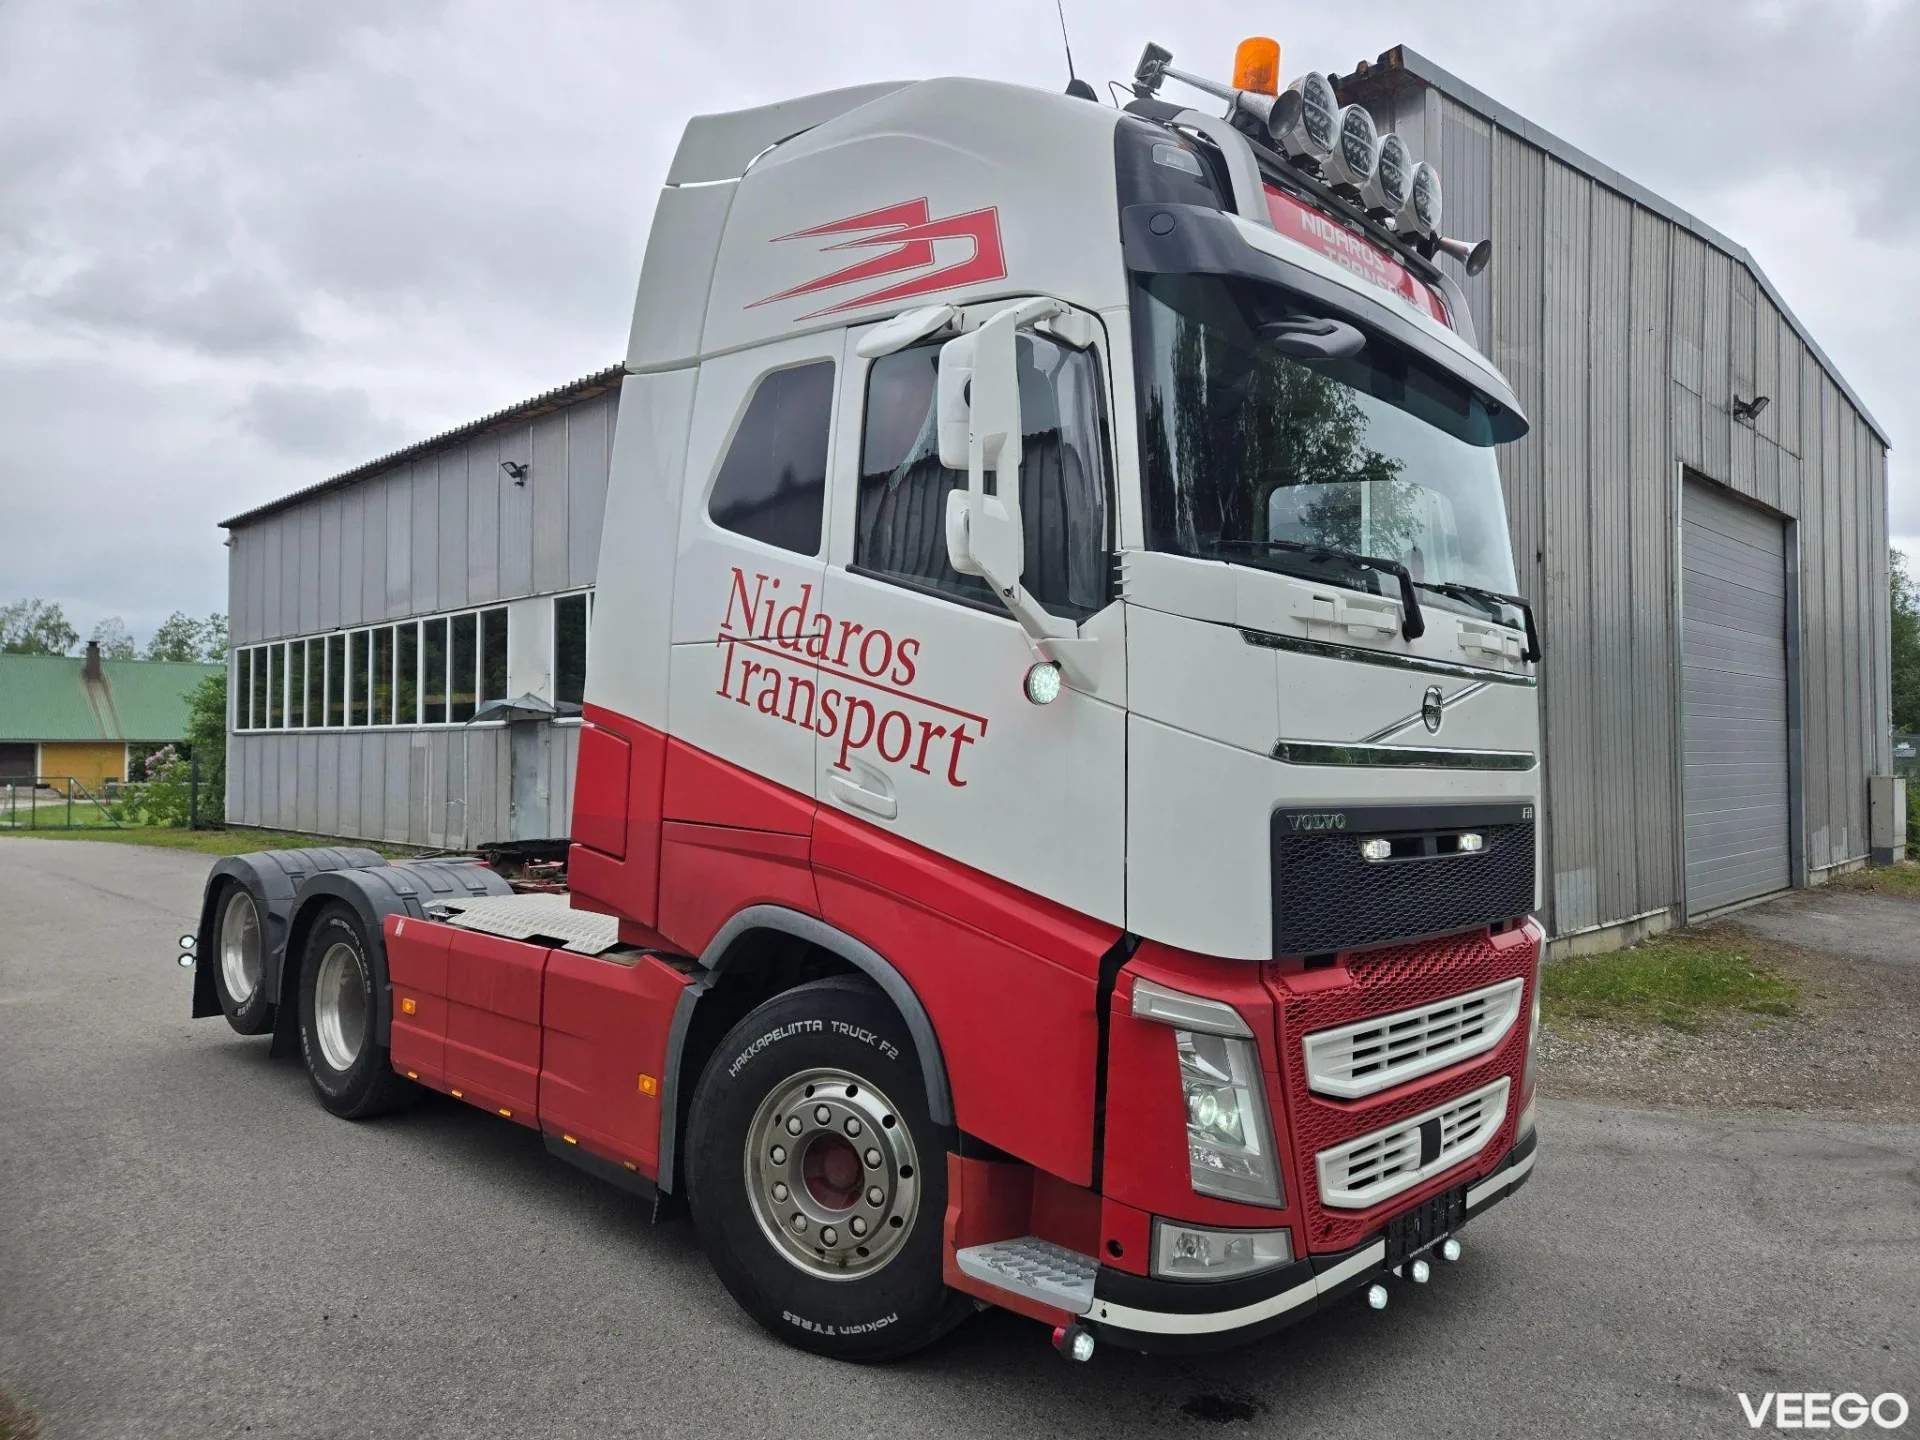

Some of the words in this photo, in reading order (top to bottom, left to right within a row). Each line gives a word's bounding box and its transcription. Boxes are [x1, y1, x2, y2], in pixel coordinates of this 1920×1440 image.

[1300, 210, 1387, 274] NIDAROS
[720, 566, 921, 686] Nidaros
[716, 632, 989, 787] Transport
[1287, 813, 1347, 831] VOLVO
[728, 1019, 823, 1077] HAKKAPELIITTA
[831, 1020, 878, 1046] TRUCK
[878, 1040, 900, 1060] F2
[782, 1310, 836, 1336] TYRES
